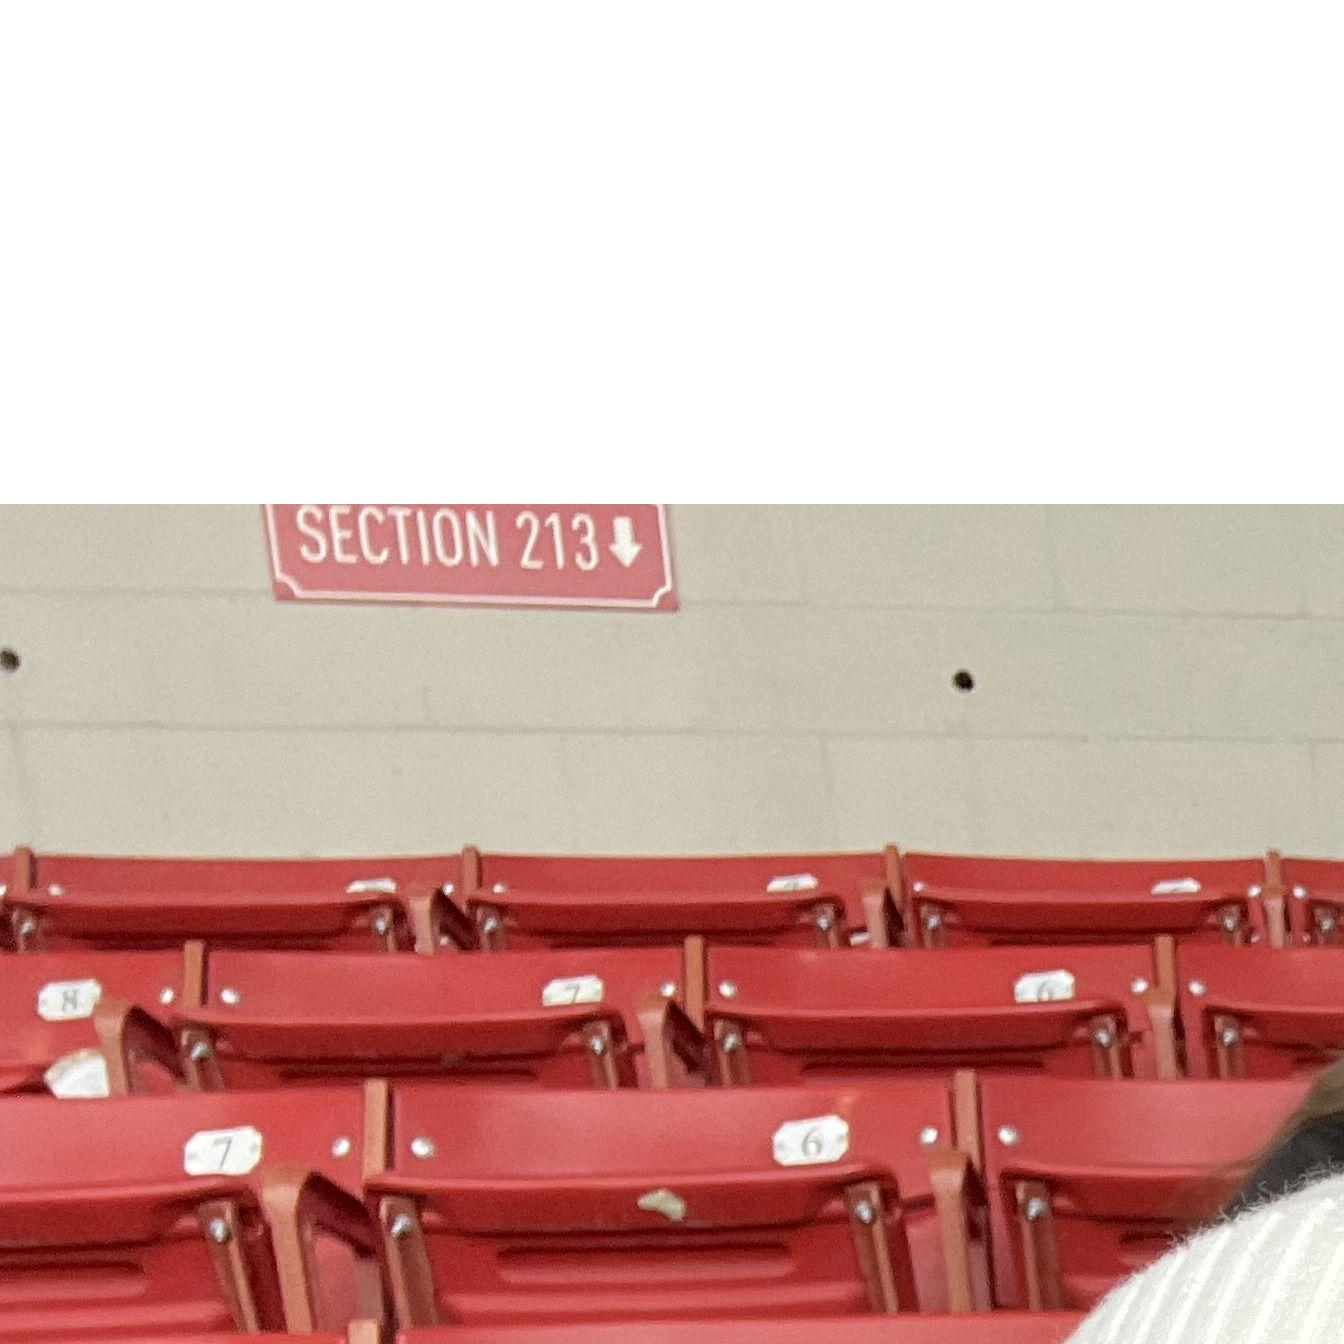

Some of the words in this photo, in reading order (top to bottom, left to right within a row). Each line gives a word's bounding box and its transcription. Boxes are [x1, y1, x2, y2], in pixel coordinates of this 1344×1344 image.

[296, 504, 500, 567] SECTION
[515, 510, 599, 571] 213
[212, 1136, 234, 1171] 7
[801, 1126, 822, 1158] 6
